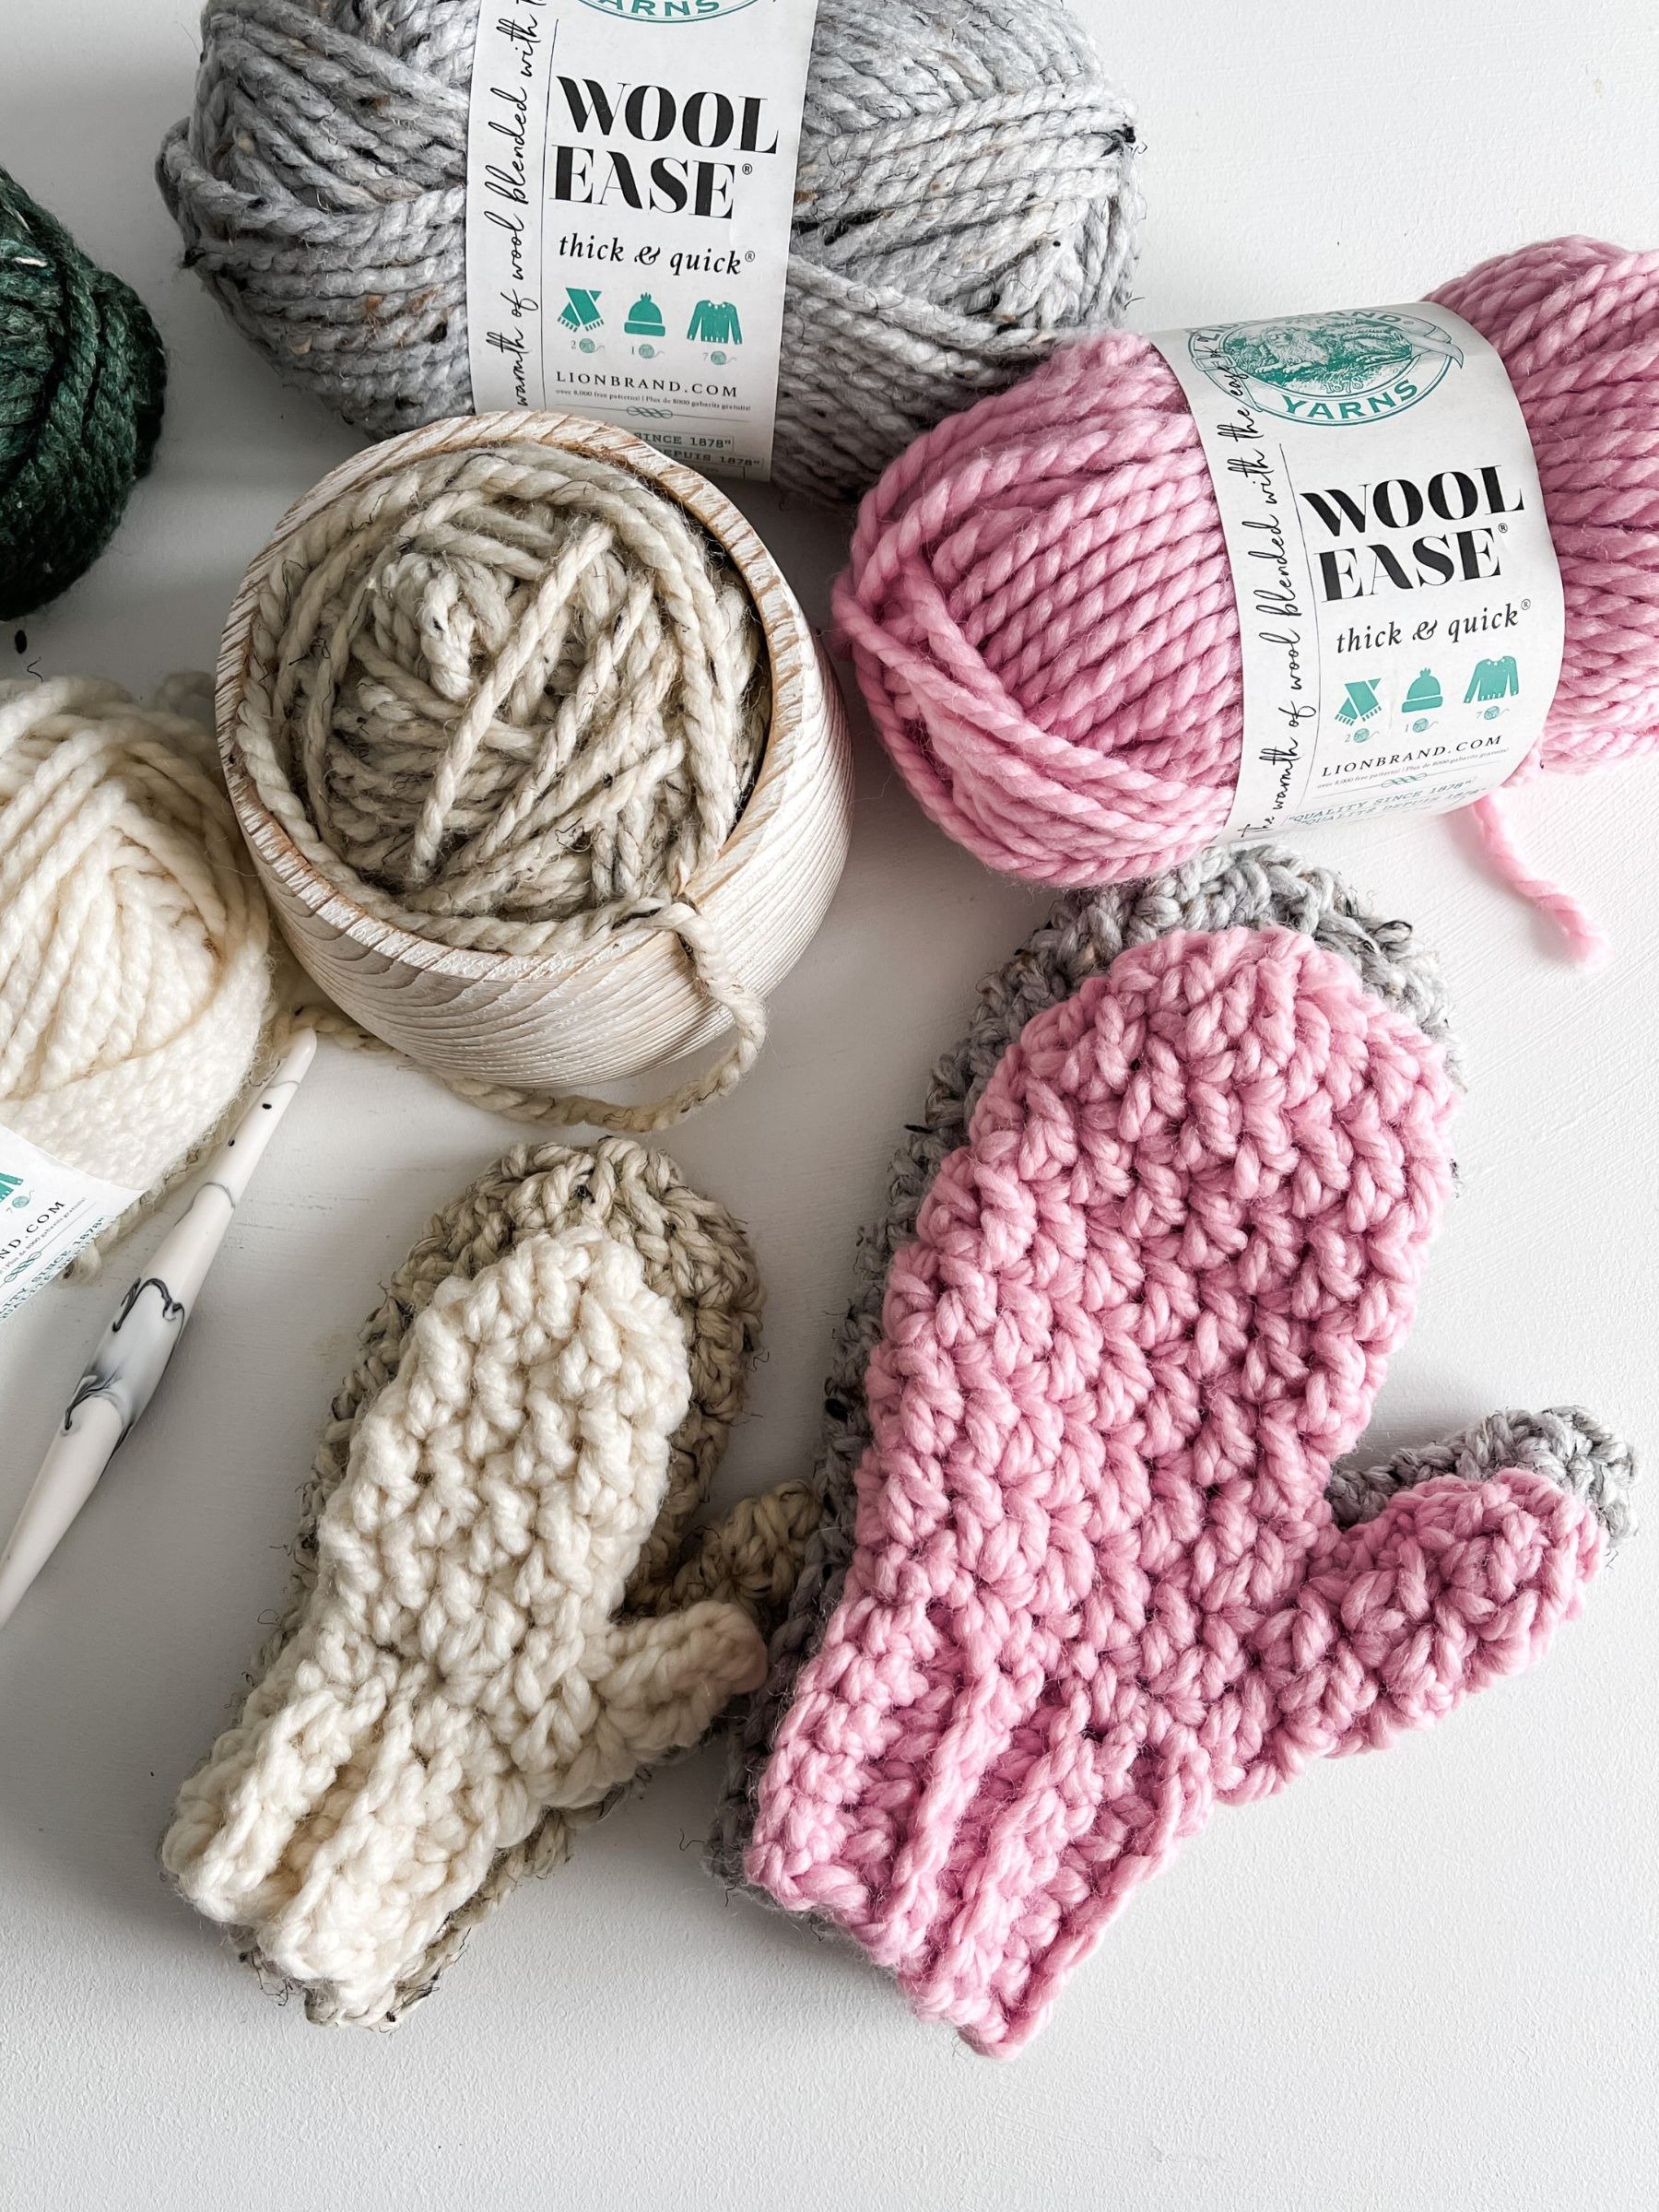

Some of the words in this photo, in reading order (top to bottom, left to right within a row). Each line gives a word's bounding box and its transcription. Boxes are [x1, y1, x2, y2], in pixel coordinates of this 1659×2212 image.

[601, 0, 720, 17] ARNS
[496, 14, 542, 77] with
[556, 76, 779, 154] WOOL
[484, 87, 530, 206] blended
[484, 210, 525, 280] wool
[559, 232, 625, 263] thick
[634, 245, 661, 265] &
[500, 288, 539, 318] of
[570, 340, 577, 349] 2
[702, 352, 709, 361] 7
[487, 326, 530, 406] warmth
[556, 371, 738, 397] LIONBRAND.COM
[1282, 379, 1418, 420] YARNS
[1217, 406, 1265, 443] the
[1227, 448, 1278, 506] with
[1300, 465, 1525, 537] WOOL
[1241, 513, 1302, 617] blended
[1336, 621, 1403, 653] thick
[1412, 619, 1438, 641] &
[1258, 628, 1302, 690] wool
[1278, 700, 1317, 728] of
[1322, 735, 1502, 778] LIONBRAND.COM
[1344, 734, 1351, 743] 2
[1258, 736, 1305, 810] warmth
